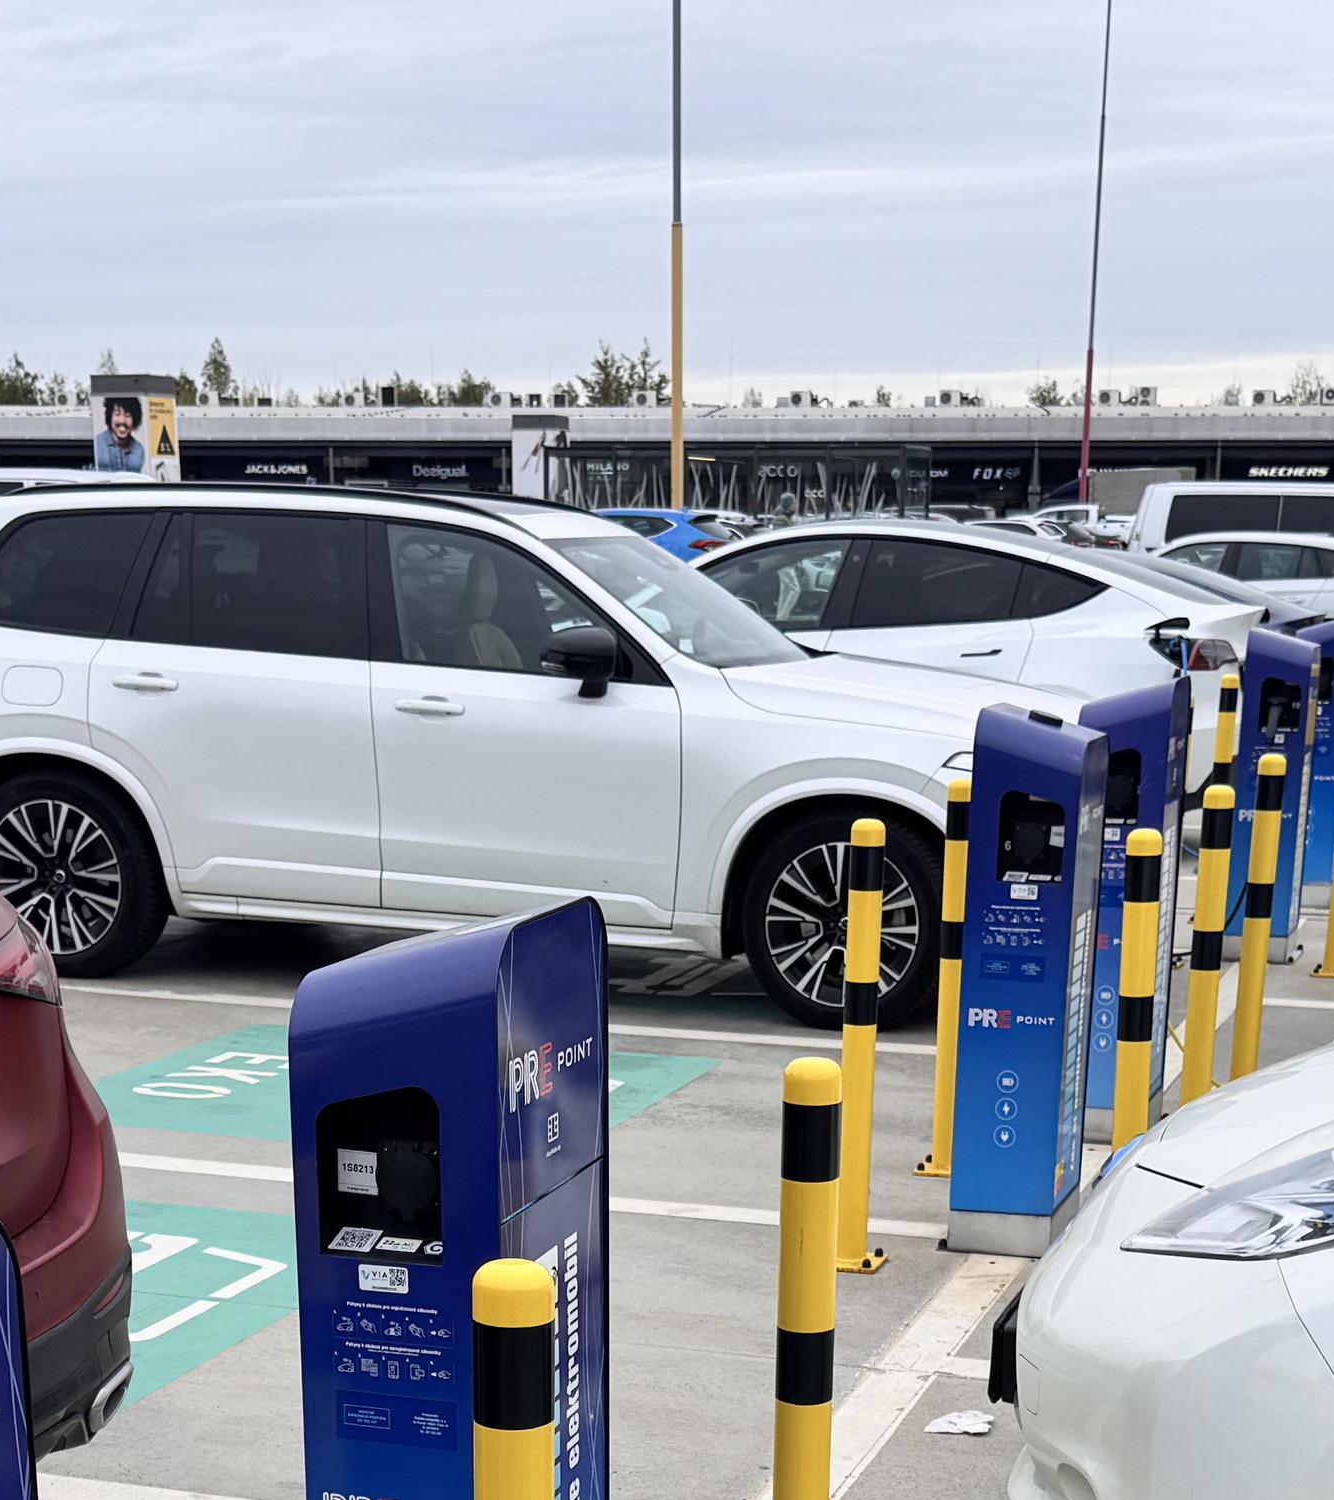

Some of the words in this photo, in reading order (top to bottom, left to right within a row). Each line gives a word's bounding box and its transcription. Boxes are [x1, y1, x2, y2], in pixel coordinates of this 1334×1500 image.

[244, 464, 308, 474] JACK&JONES
[972, 468, 1003, 480] FOX
[1248, 465, 1330, 477] SKECHERS
[968, 1008, 1011, 1029] PRE
[1016, 1015, 1056, 1026] POINT
[508, 1041, 554, 1113] PRE
[557, 1037, 593, 1072] POINT
[563, 1231, 581, 1470] elektromobil
